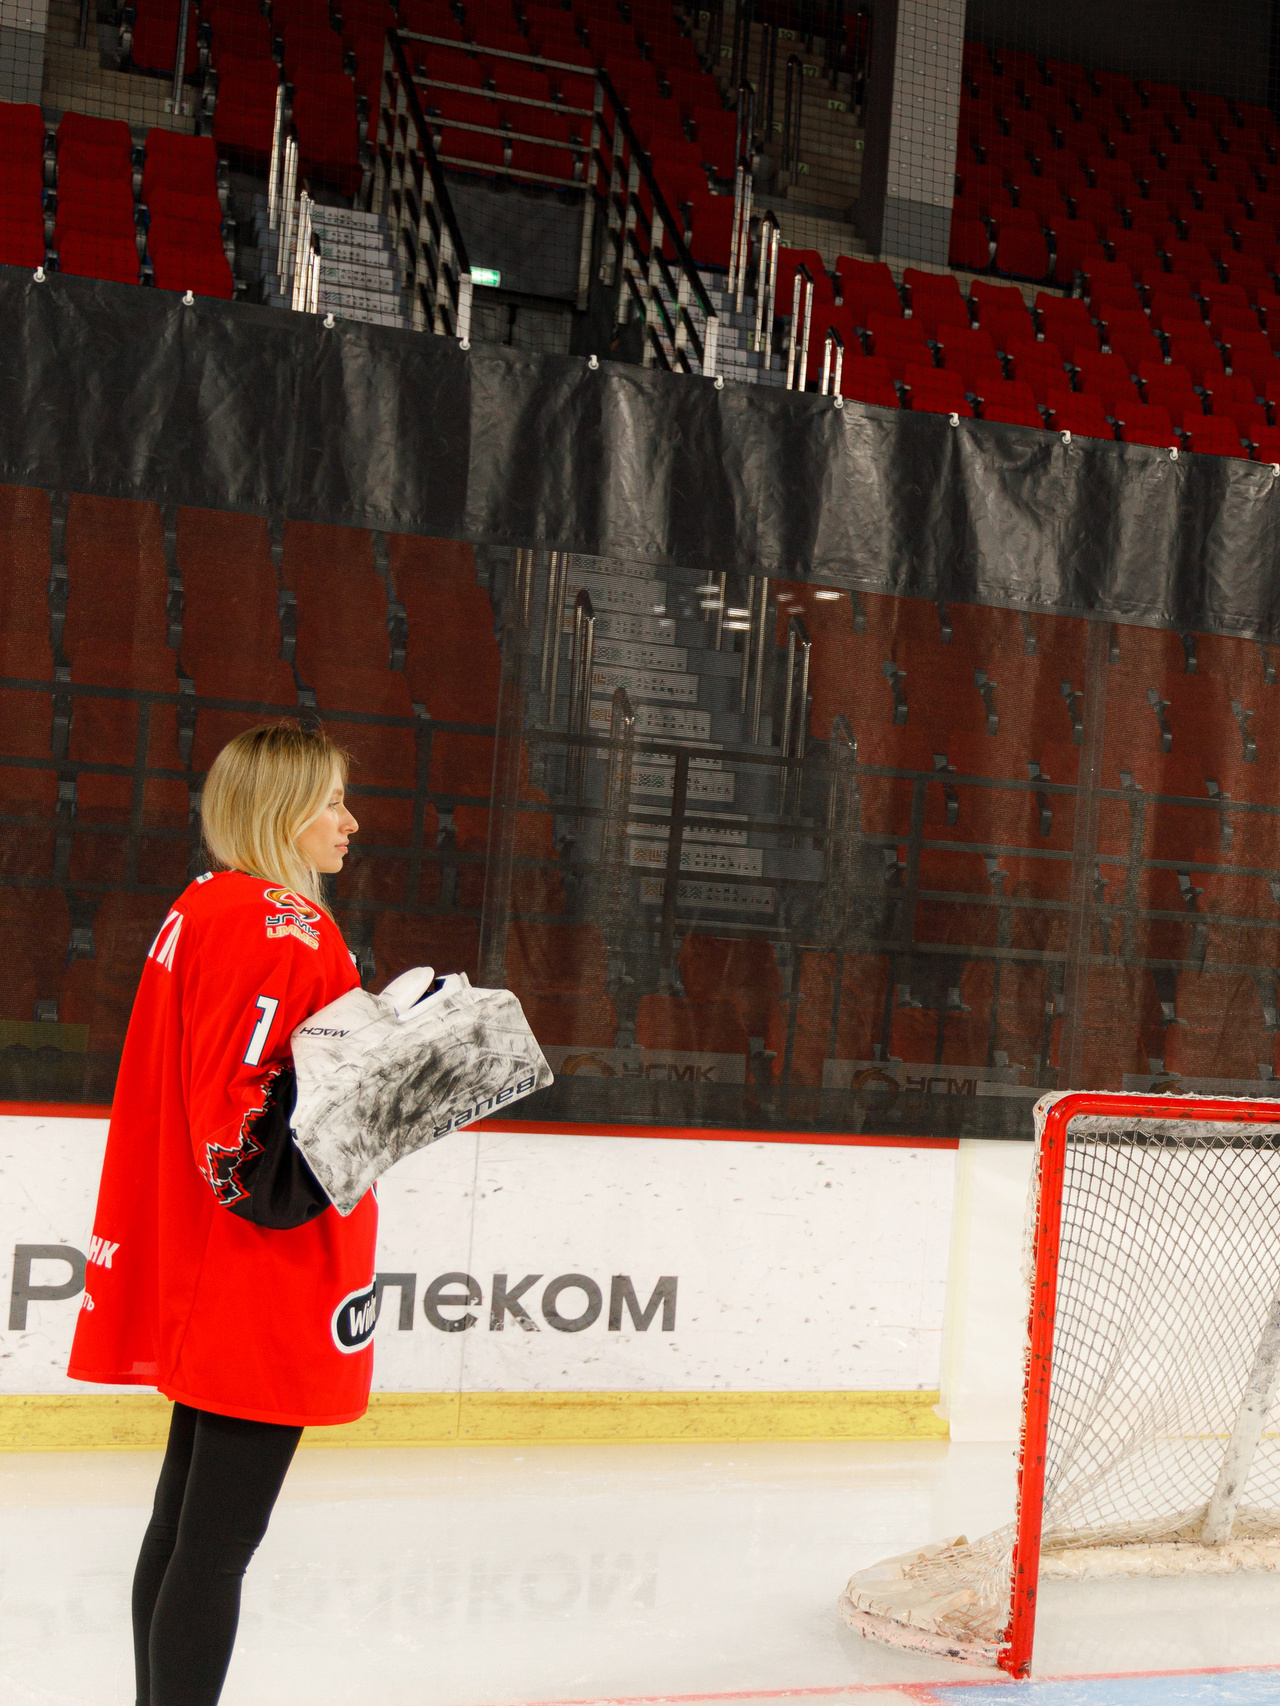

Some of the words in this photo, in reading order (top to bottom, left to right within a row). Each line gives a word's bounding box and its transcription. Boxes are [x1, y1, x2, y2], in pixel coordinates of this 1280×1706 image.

[243, 994, 280, 1067] 1
[299, 1027, 350, 1038] MACH
[432, 1074, 536, 1139] BAUER
